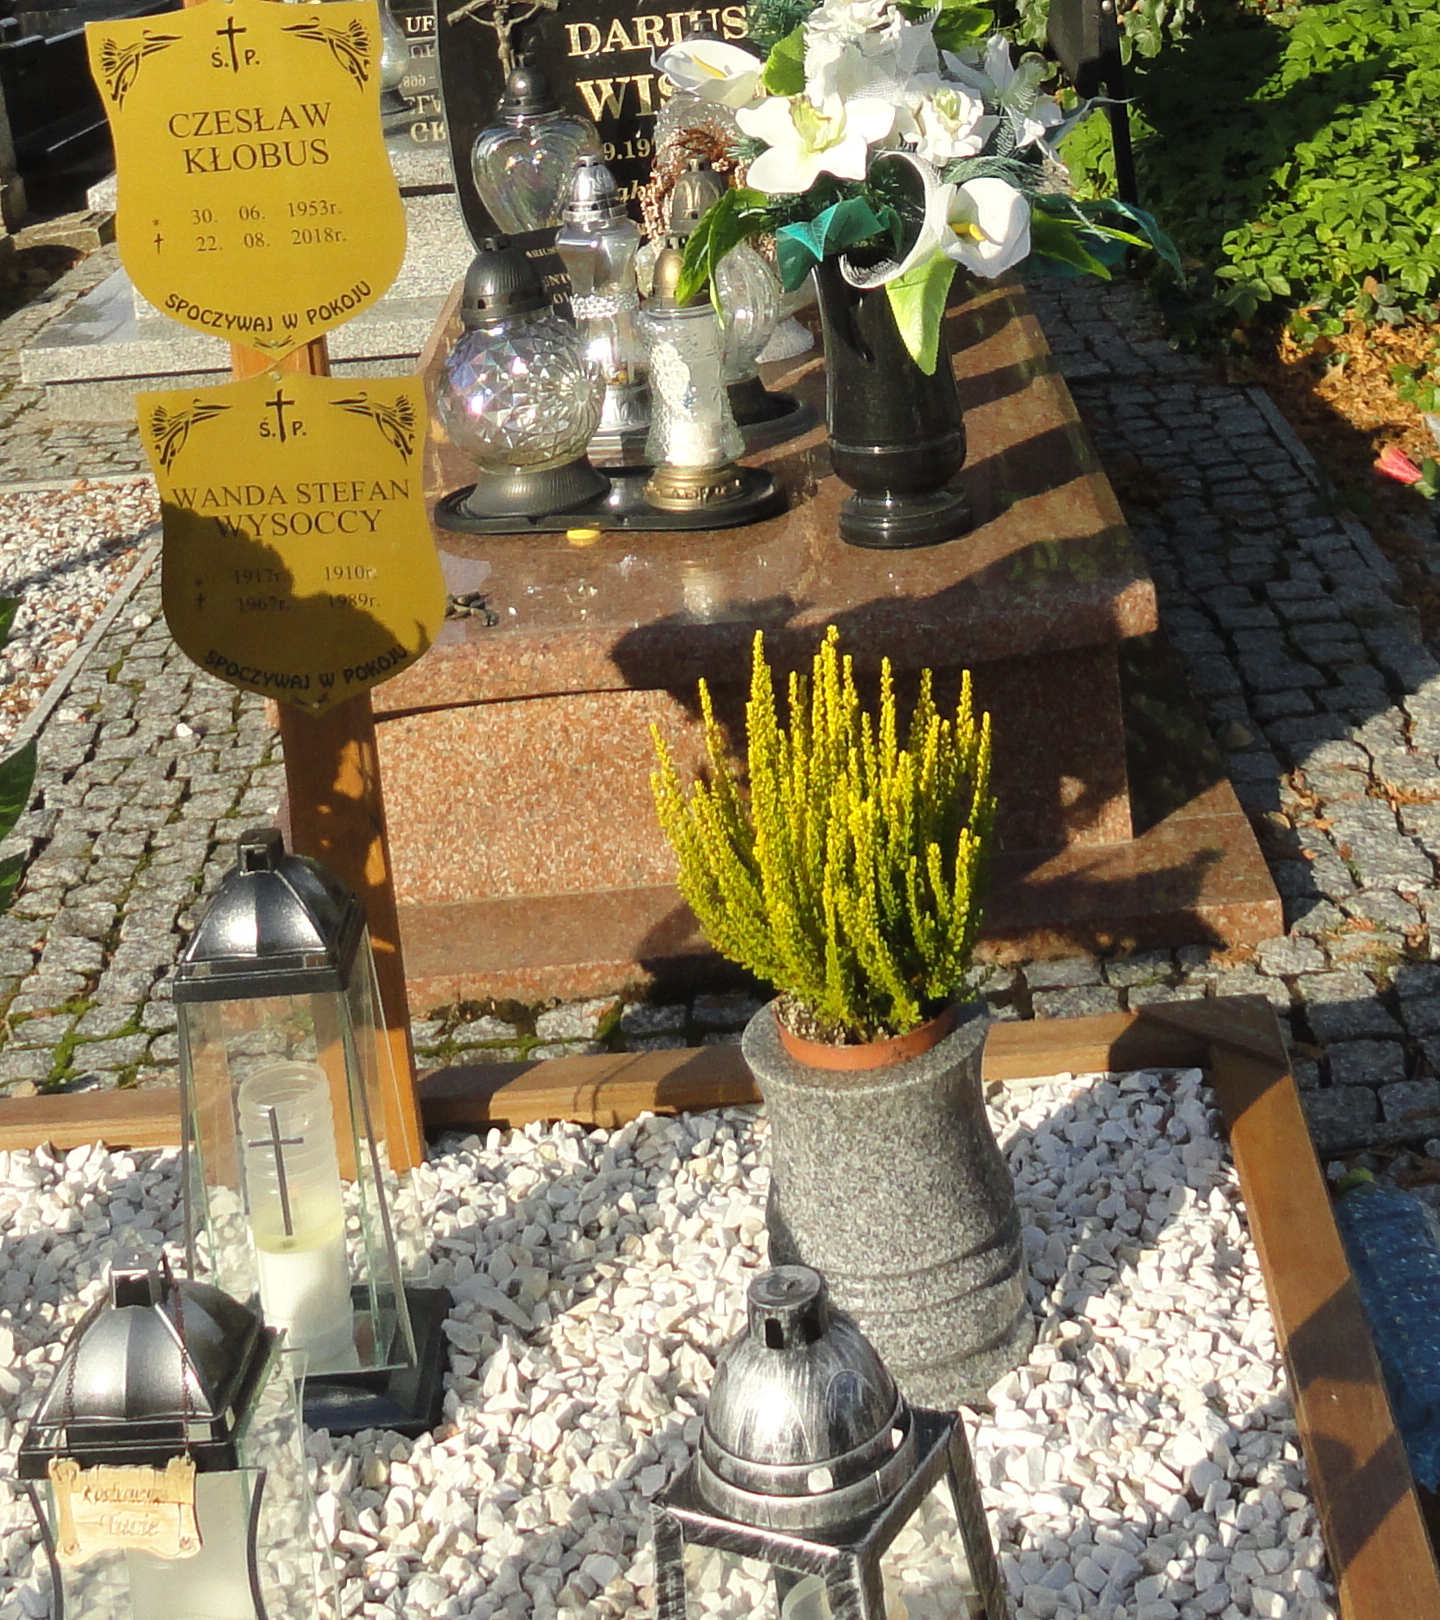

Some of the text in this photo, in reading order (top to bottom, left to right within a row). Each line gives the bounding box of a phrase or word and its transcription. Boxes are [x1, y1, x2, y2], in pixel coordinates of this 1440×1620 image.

[168, 102, 332, 139] CZESŁAW
[184, 138, 330, 174] KŁOBUS
[191, 198, 343, 226] 30. 06. 1953r.
[196, 226, 347, 253] 22. 08. 2018r.
[164, 279, 372, 333] SPOCZYWAJ W POKOJU
[171, 479, 410, 510] WANDA STEFAN
[215, 508, 383, 538] WYSOCCY
[204, 644, 409, 691] SPOCZYWAJ W POKOJU
